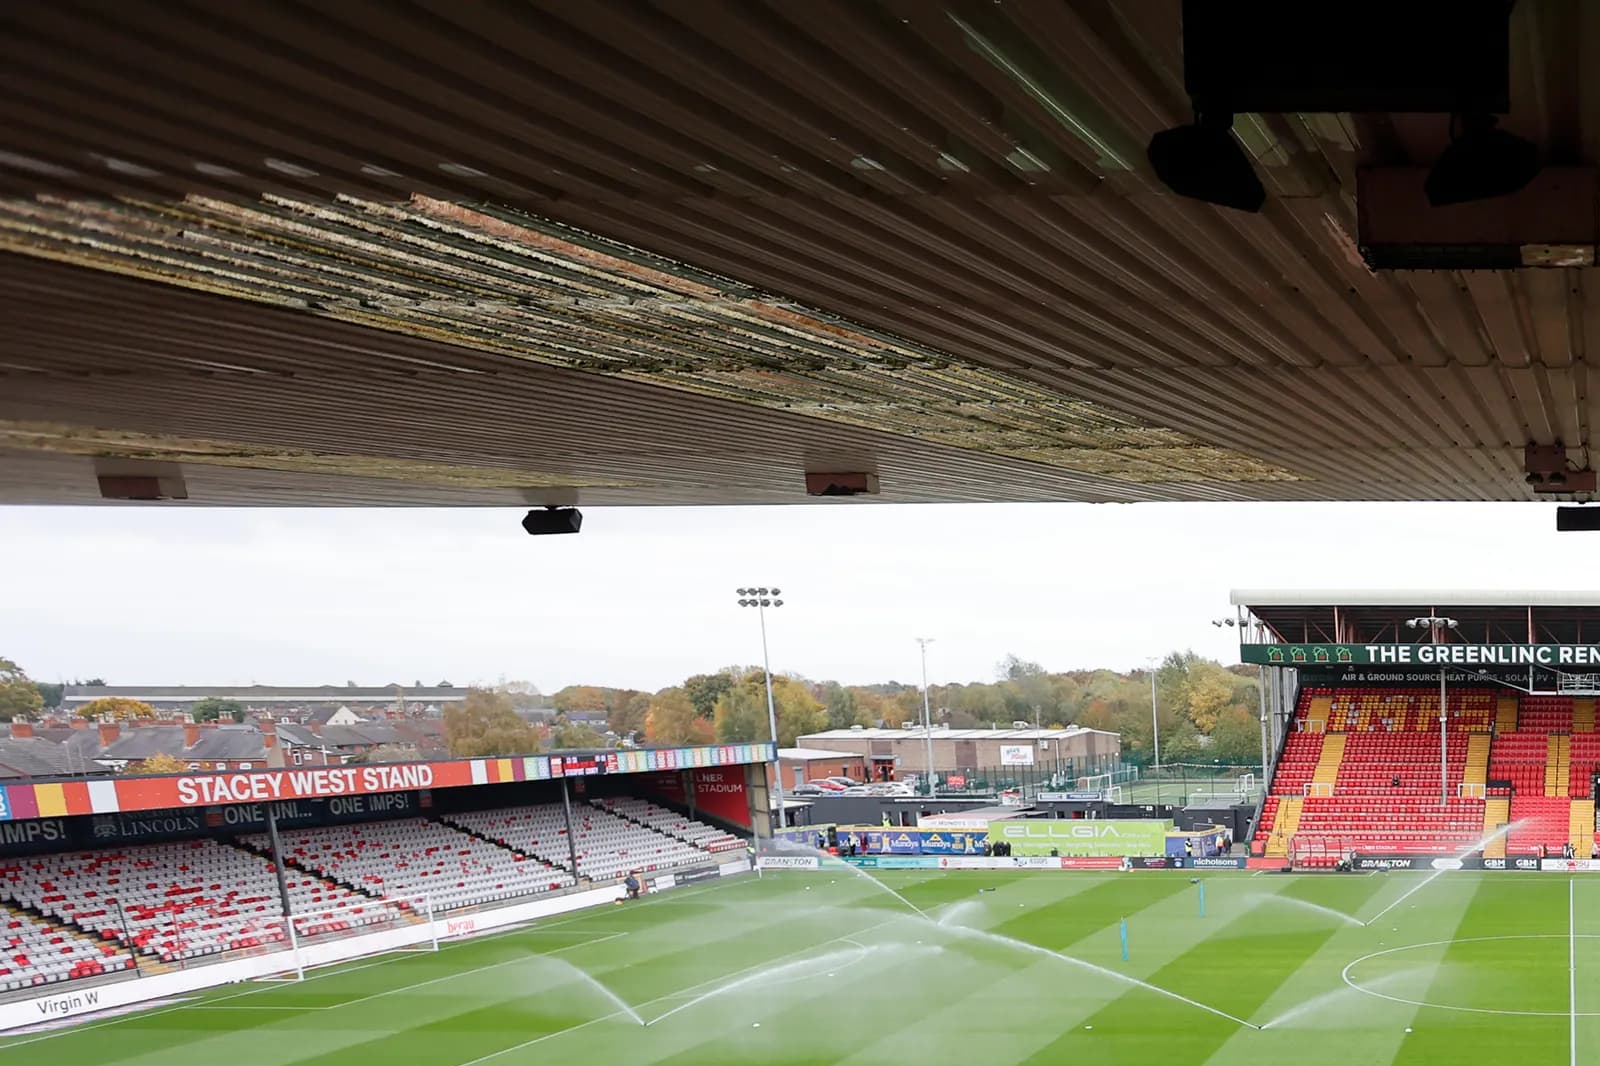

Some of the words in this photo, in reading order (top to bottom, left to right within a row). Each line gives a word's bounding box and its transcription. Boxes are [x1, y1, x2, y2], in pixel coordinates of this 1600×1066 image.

[1366, 646, 1411, 663] THE
[1418, 645, 1552, 663] GREENLINC
[1341, 673, 1357, 681] AIR
[1358, 673, 1366, 681] &
[1367, 673, 1404, 681] GROUND
[1406, 673, 1442, 681] SOURCE
[177, 772, 283, 804] STACEY
[288, 769, 357, 796] WEST
[363, 764, 433, 790] STAND
[697, 784, 743, 793] STADIUM
[330, 797, 364, 815] ONE
[369, 793, 409, 811] IMPS!
[224, 804, 264, 825] ONE
[121, 816, 199, 837] LINCOLN
[1003, 825, 1121, 839] ELLGIA
[1193, 857, 1238, 867] nicholsons
[1483, 859, 1506, 867] GBM
[1515, 859, 1537, 867] GBM
[37, 996, 82, 1015] Virgin
[85, 991, 99, 1005] W
